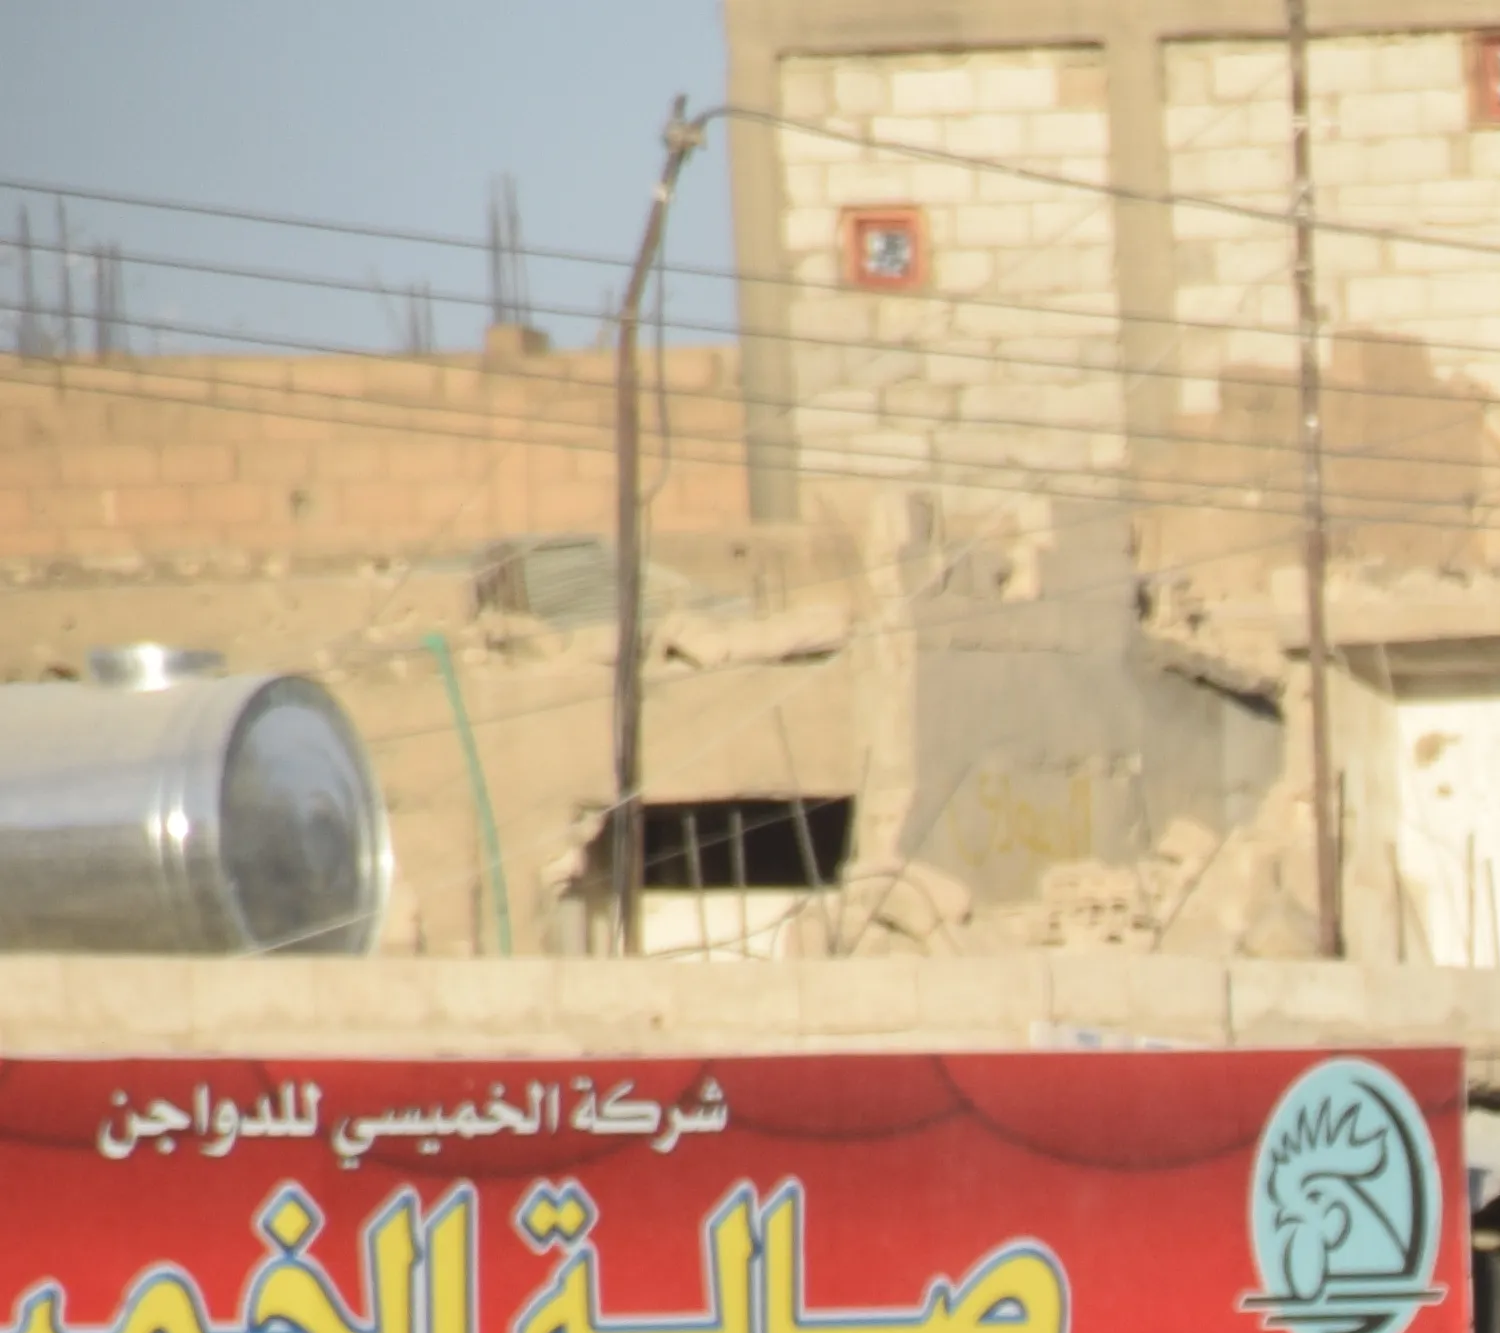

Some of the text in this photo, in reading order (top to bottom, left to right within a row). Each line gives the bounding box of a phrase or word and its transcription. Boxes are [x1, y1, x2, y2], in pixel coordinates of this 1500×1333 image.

[96, 1076, 730, 1168] شركة الخميسي للدواجن
